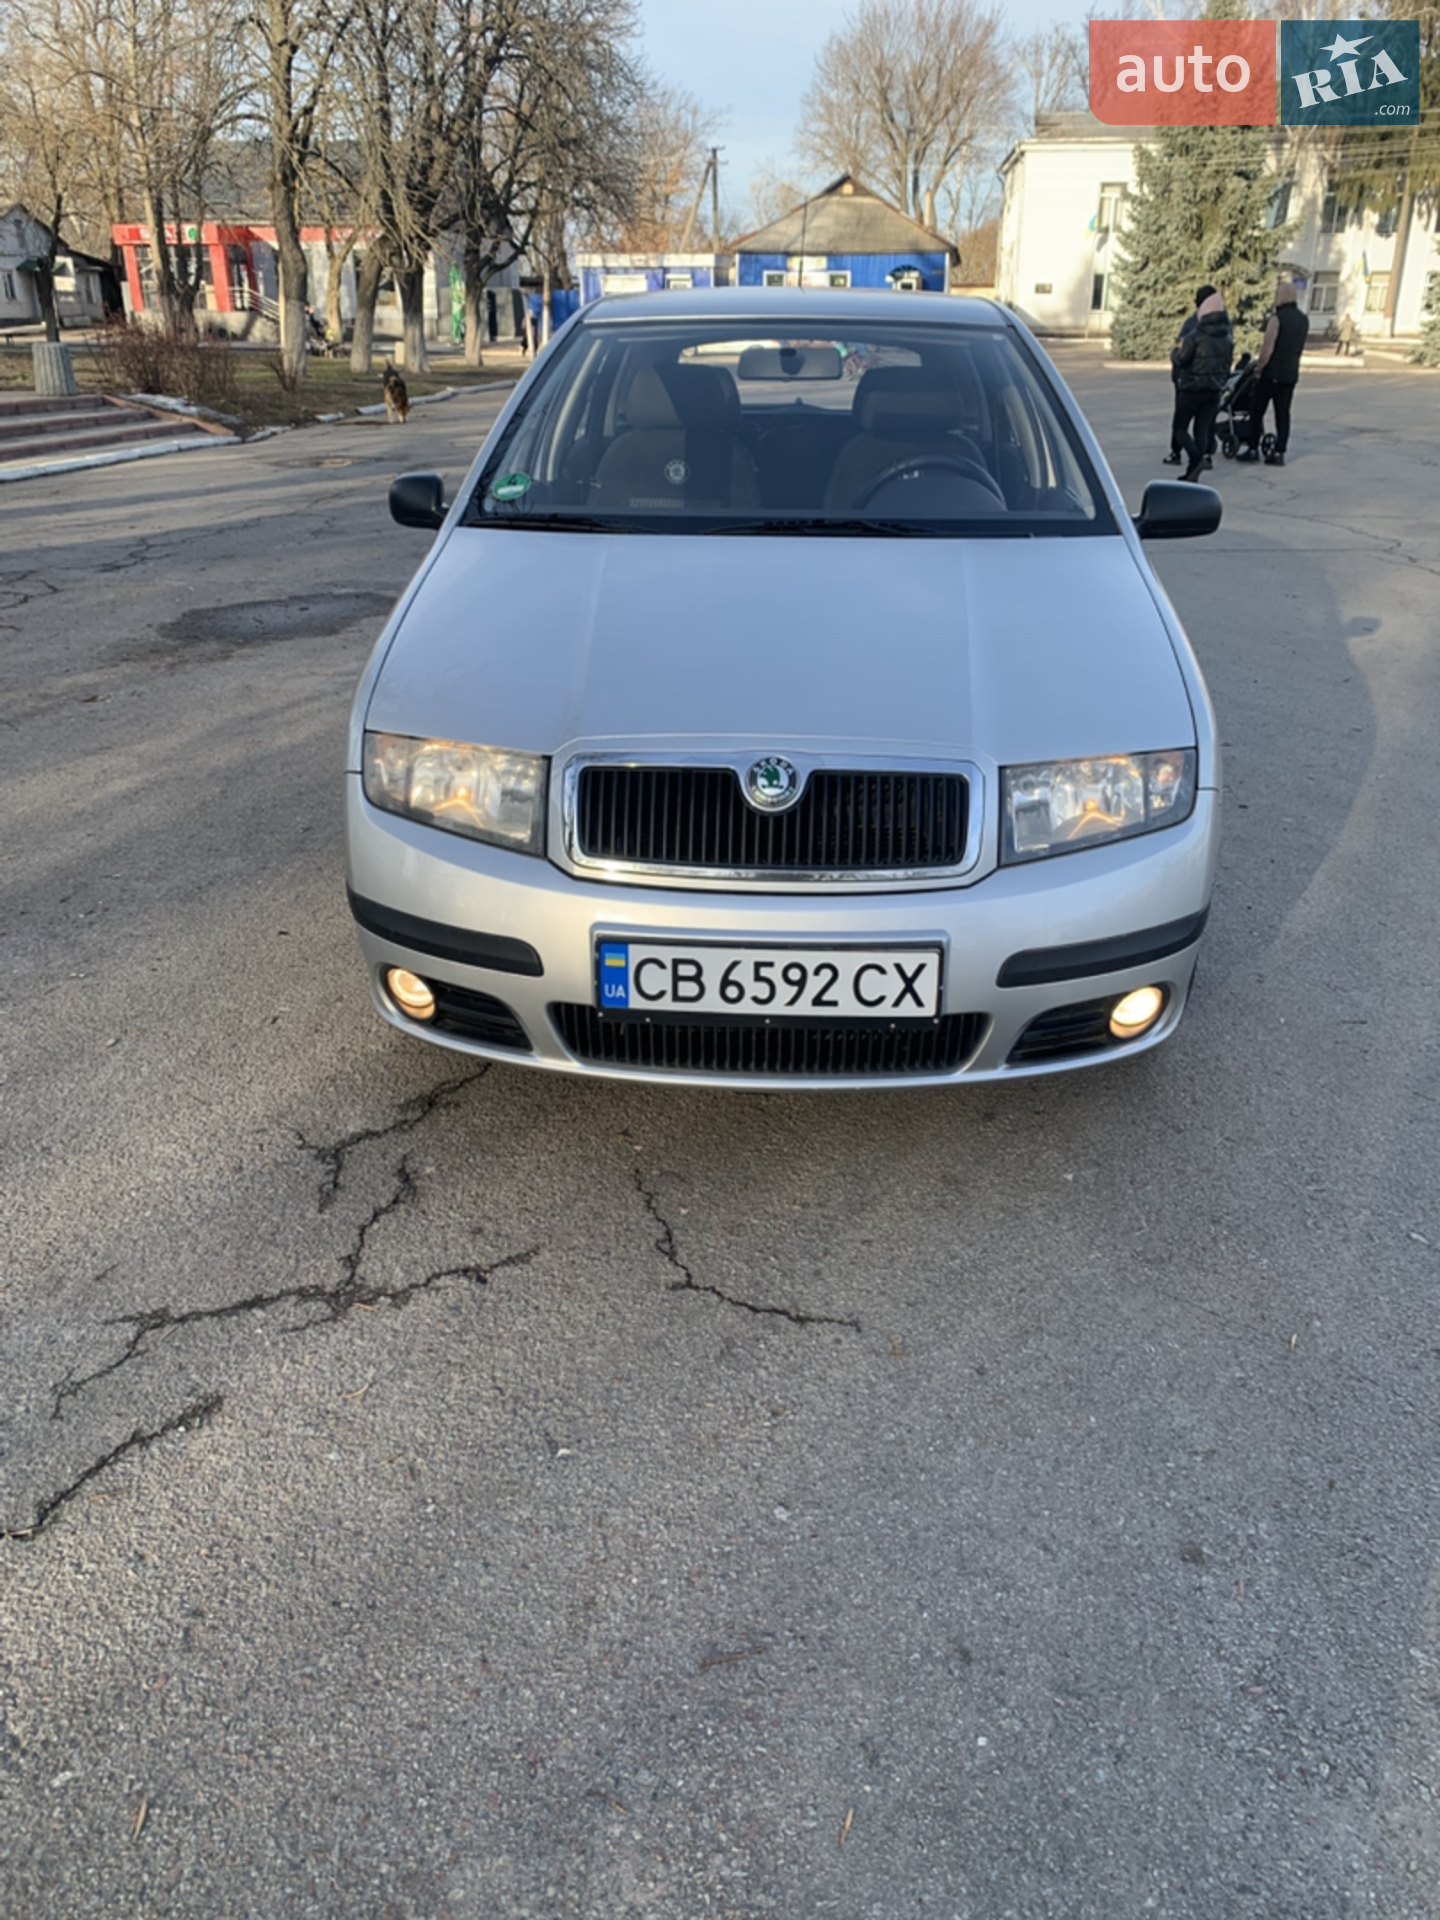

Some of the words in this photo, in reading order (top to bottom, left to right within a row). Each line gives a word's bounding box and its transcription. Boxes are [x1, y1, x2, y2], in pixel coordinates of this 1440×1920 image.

[604, 984, 627, 999] UA
[633, 957, 706, 1004] CB
[719, 960, 839, 1007] 6592
[852, 963, 927, 1009] CX
